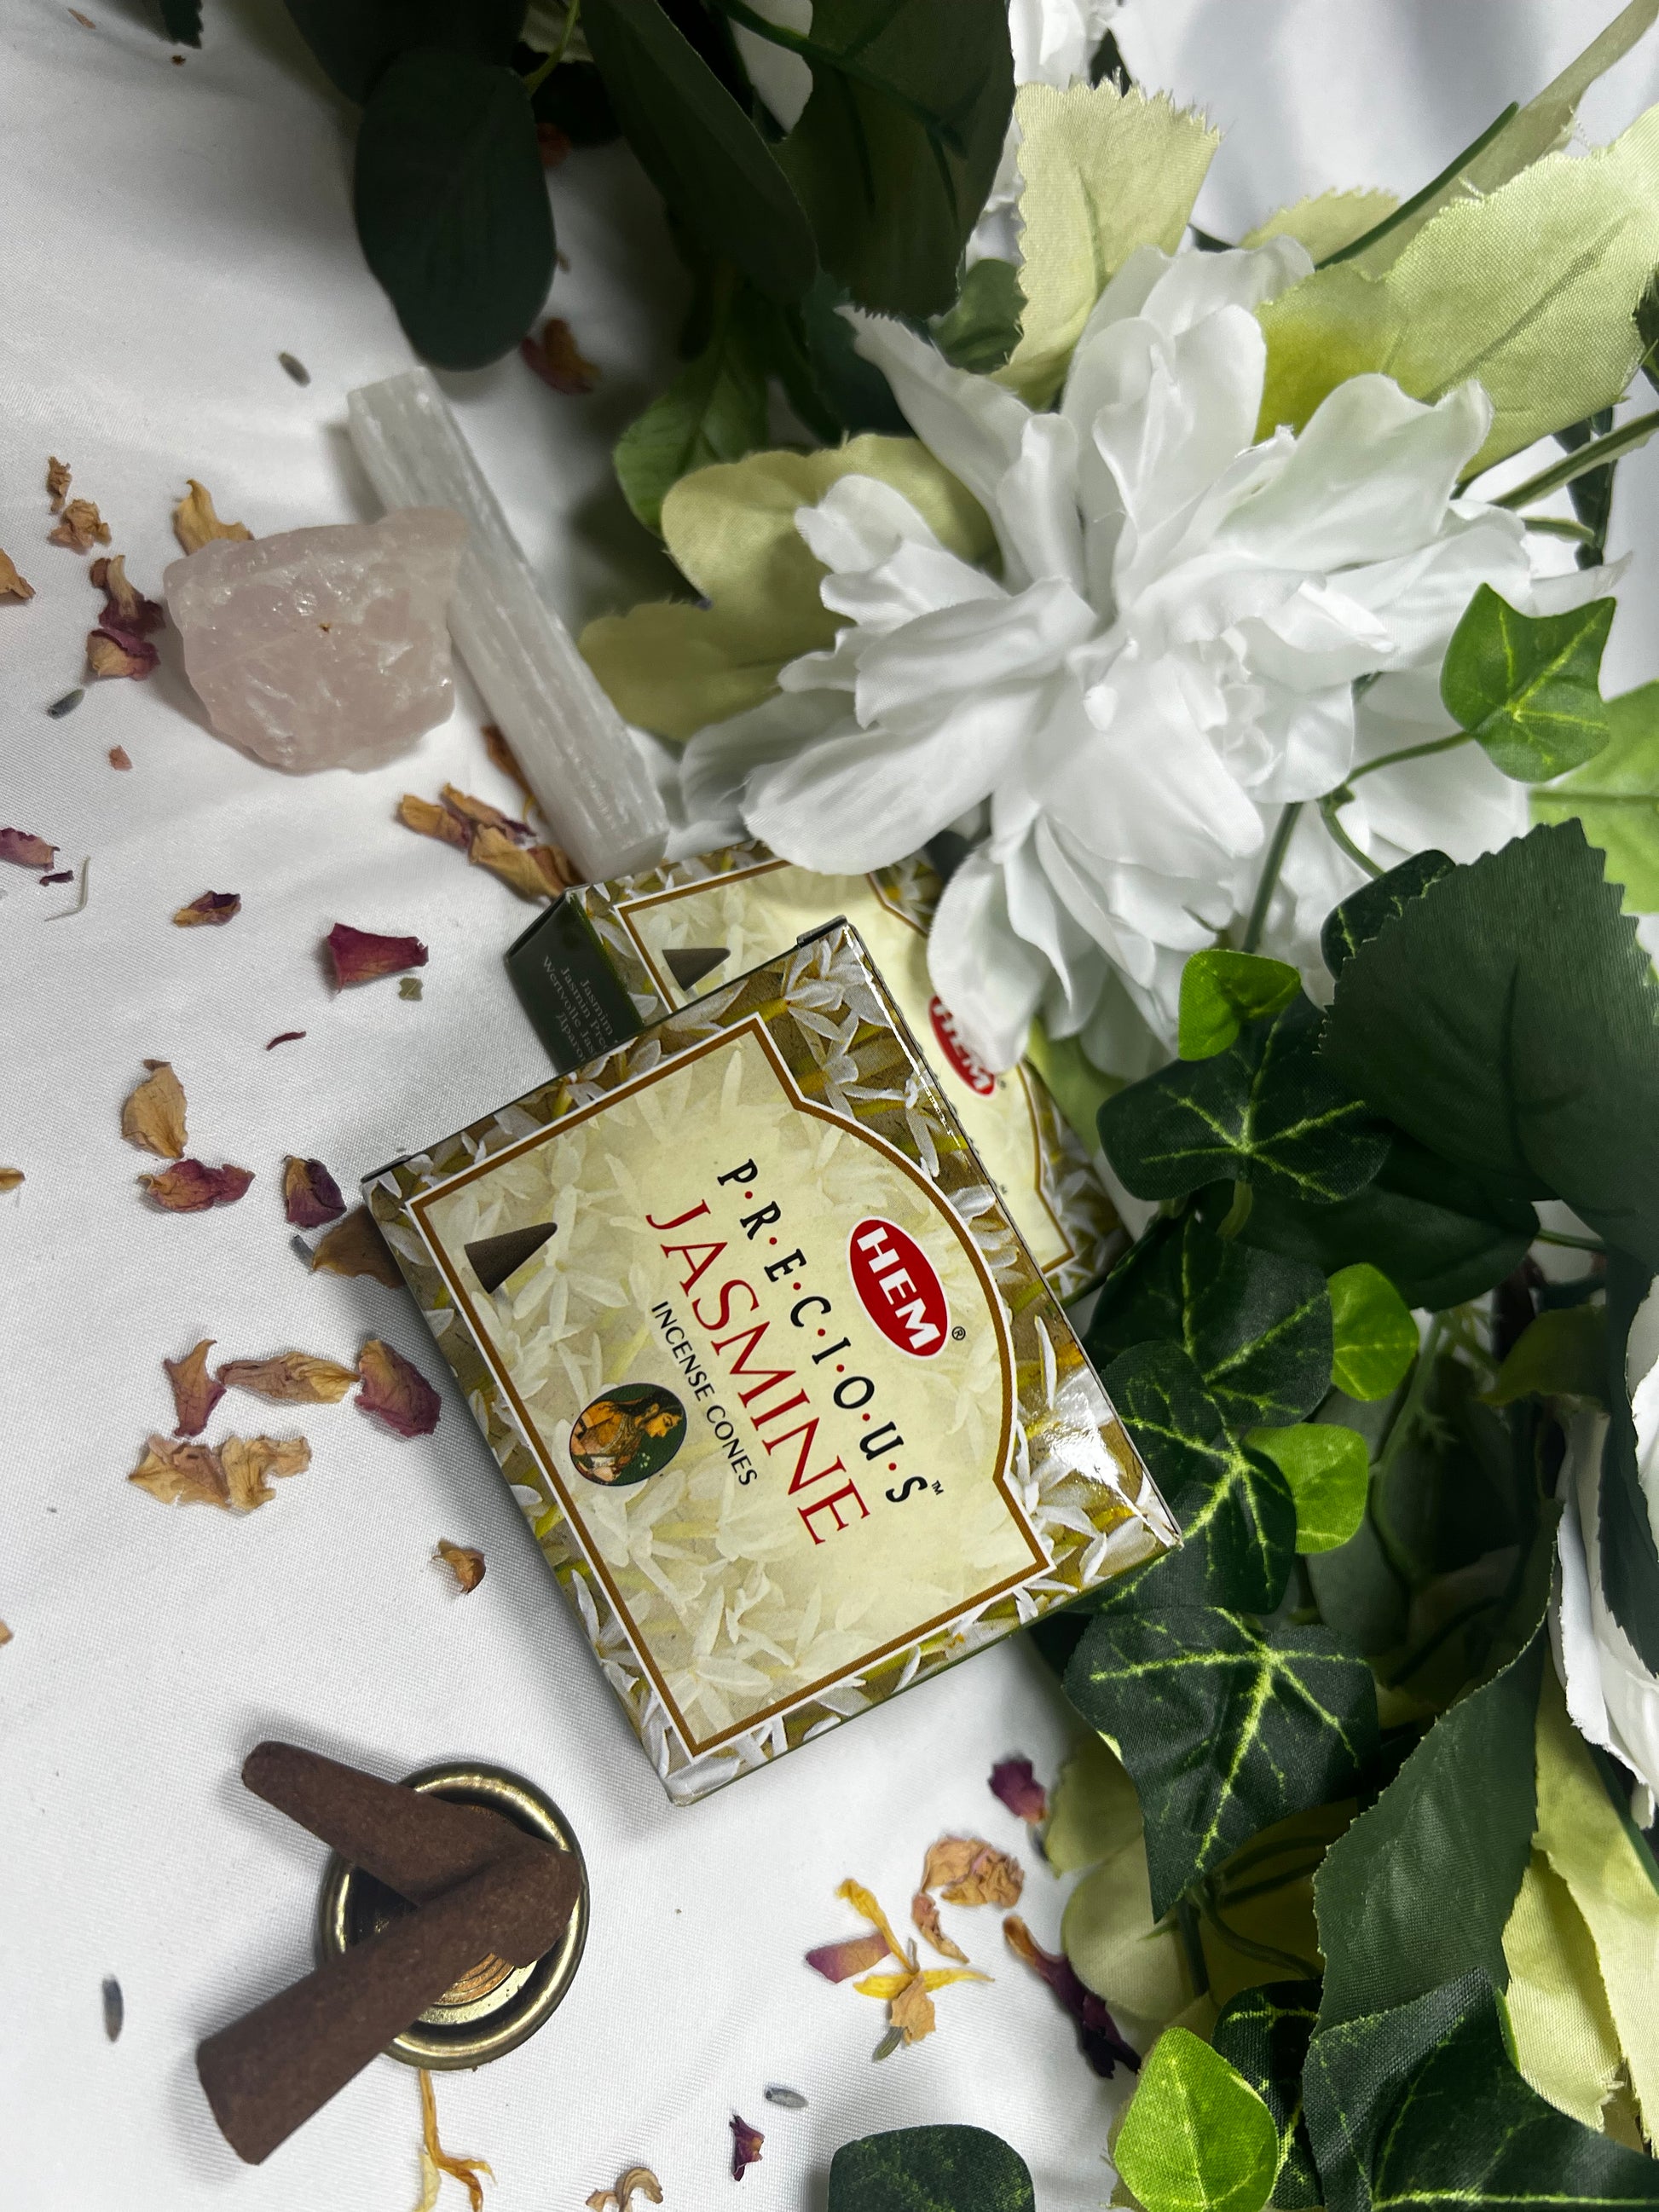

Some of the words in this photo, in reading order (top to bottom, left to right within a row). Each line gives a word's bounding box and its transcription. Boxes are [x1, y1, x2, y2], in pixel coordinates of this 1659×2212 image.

[543, 955, 581, 1028] Wertvolle
[580, 1030, 598, 1057] Jas
[560, 966, 591, 1018] Jasmin
[580, 979, 614, 1035] Jasmim
[856, 1226, 941, 1351] HEM
[645, 1199, 871, 1545] JASMINE
[651, 1301, 715, 1402] INCENSE
[707, 1405, 758, 1486] CONES
